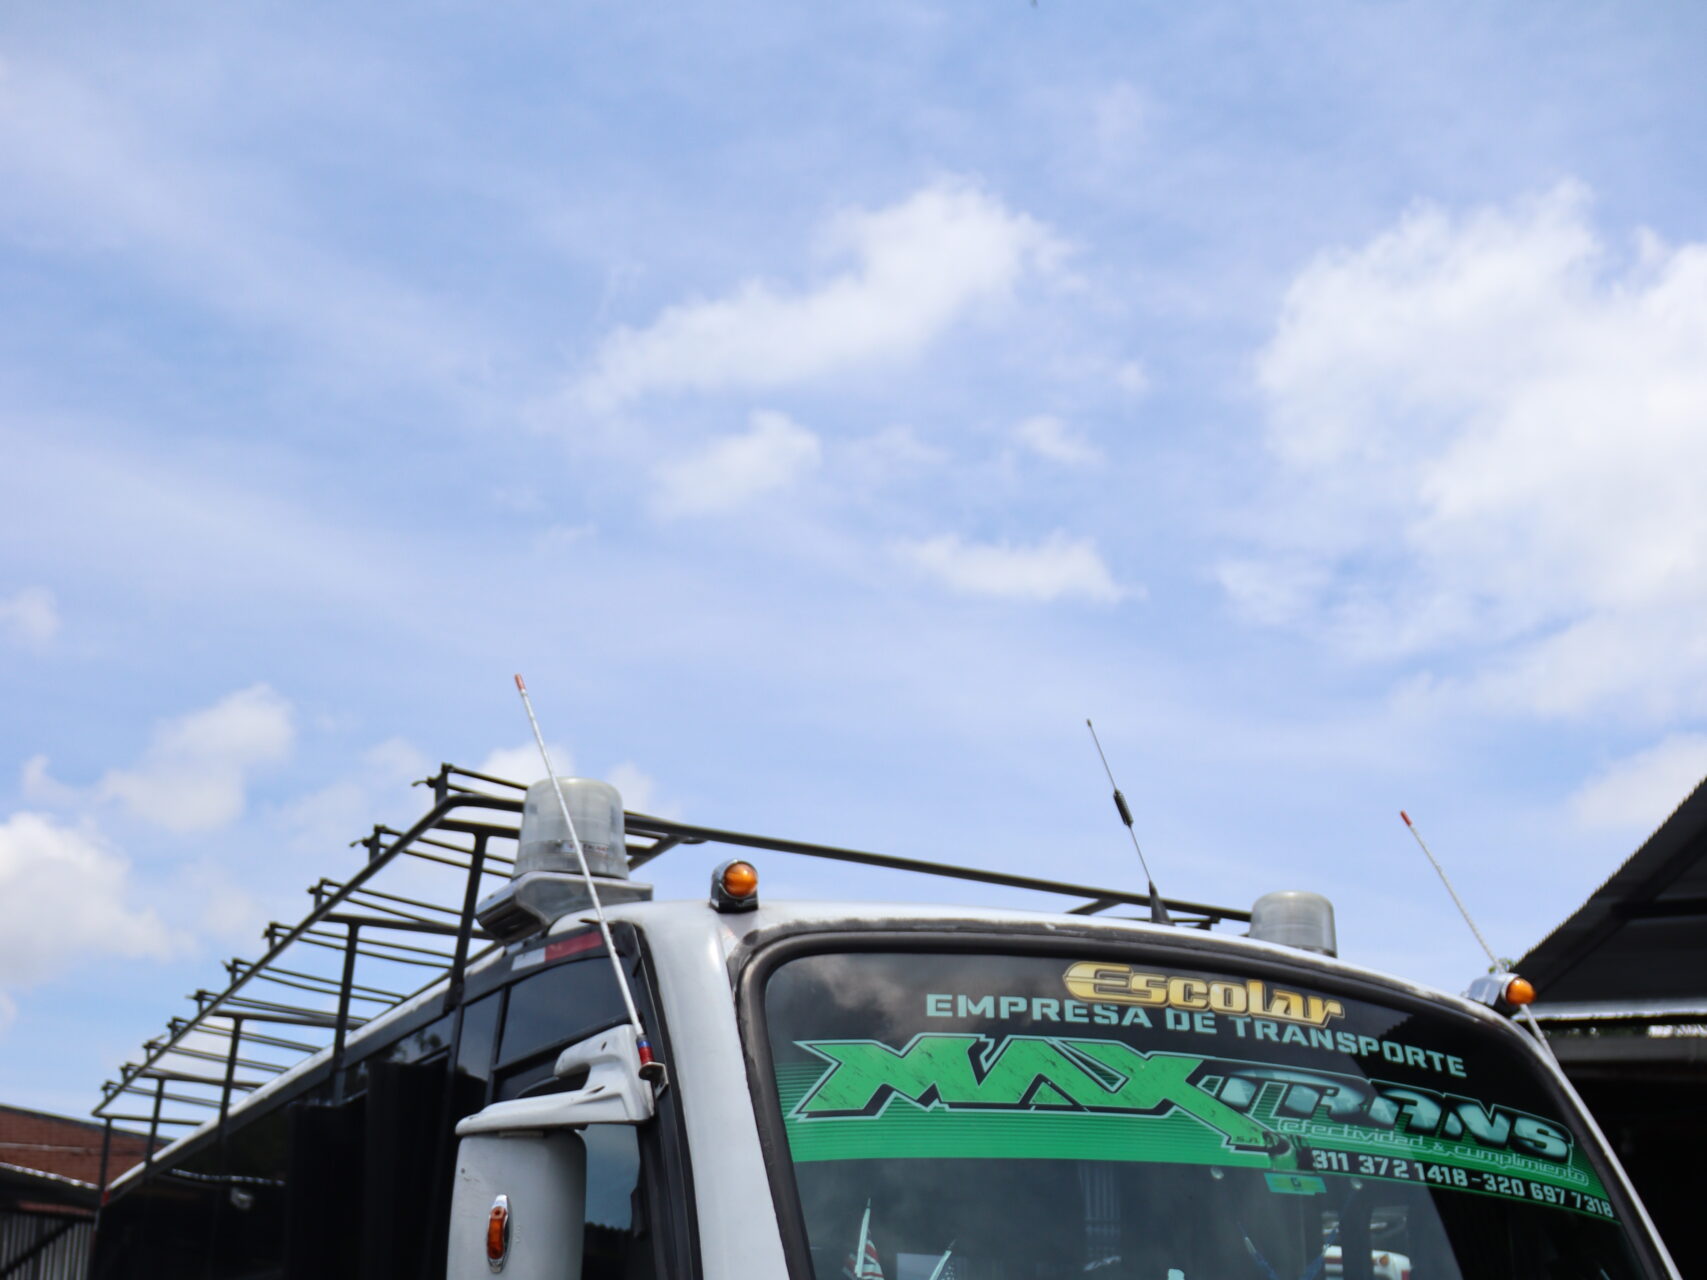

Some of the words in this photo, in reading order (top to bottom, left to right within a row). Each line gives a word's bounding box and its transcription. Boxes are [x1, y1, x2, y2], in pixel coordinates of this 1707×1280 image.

[1063, 961, 1345, 1028] Escolar
[926, 993, 1153, 1028] EMPRESA
[1165, 1007, 1217, 1033] DE
[1229, 1016, 1467, 1078] TRANSPORTE
[787, 1032, 1268, 1155] MAX
[1283, 1119, 1423, 1146] efectividad
[1455, 1145, 1586, 1182] cumplimiento
[1312, 1149, 1349, 1171] 311
[1359, 1154, 1409, 1179] 372
[1531, 1182, 1566, 1205] 697
[1574, 1190, 1614, 1219] 7318
